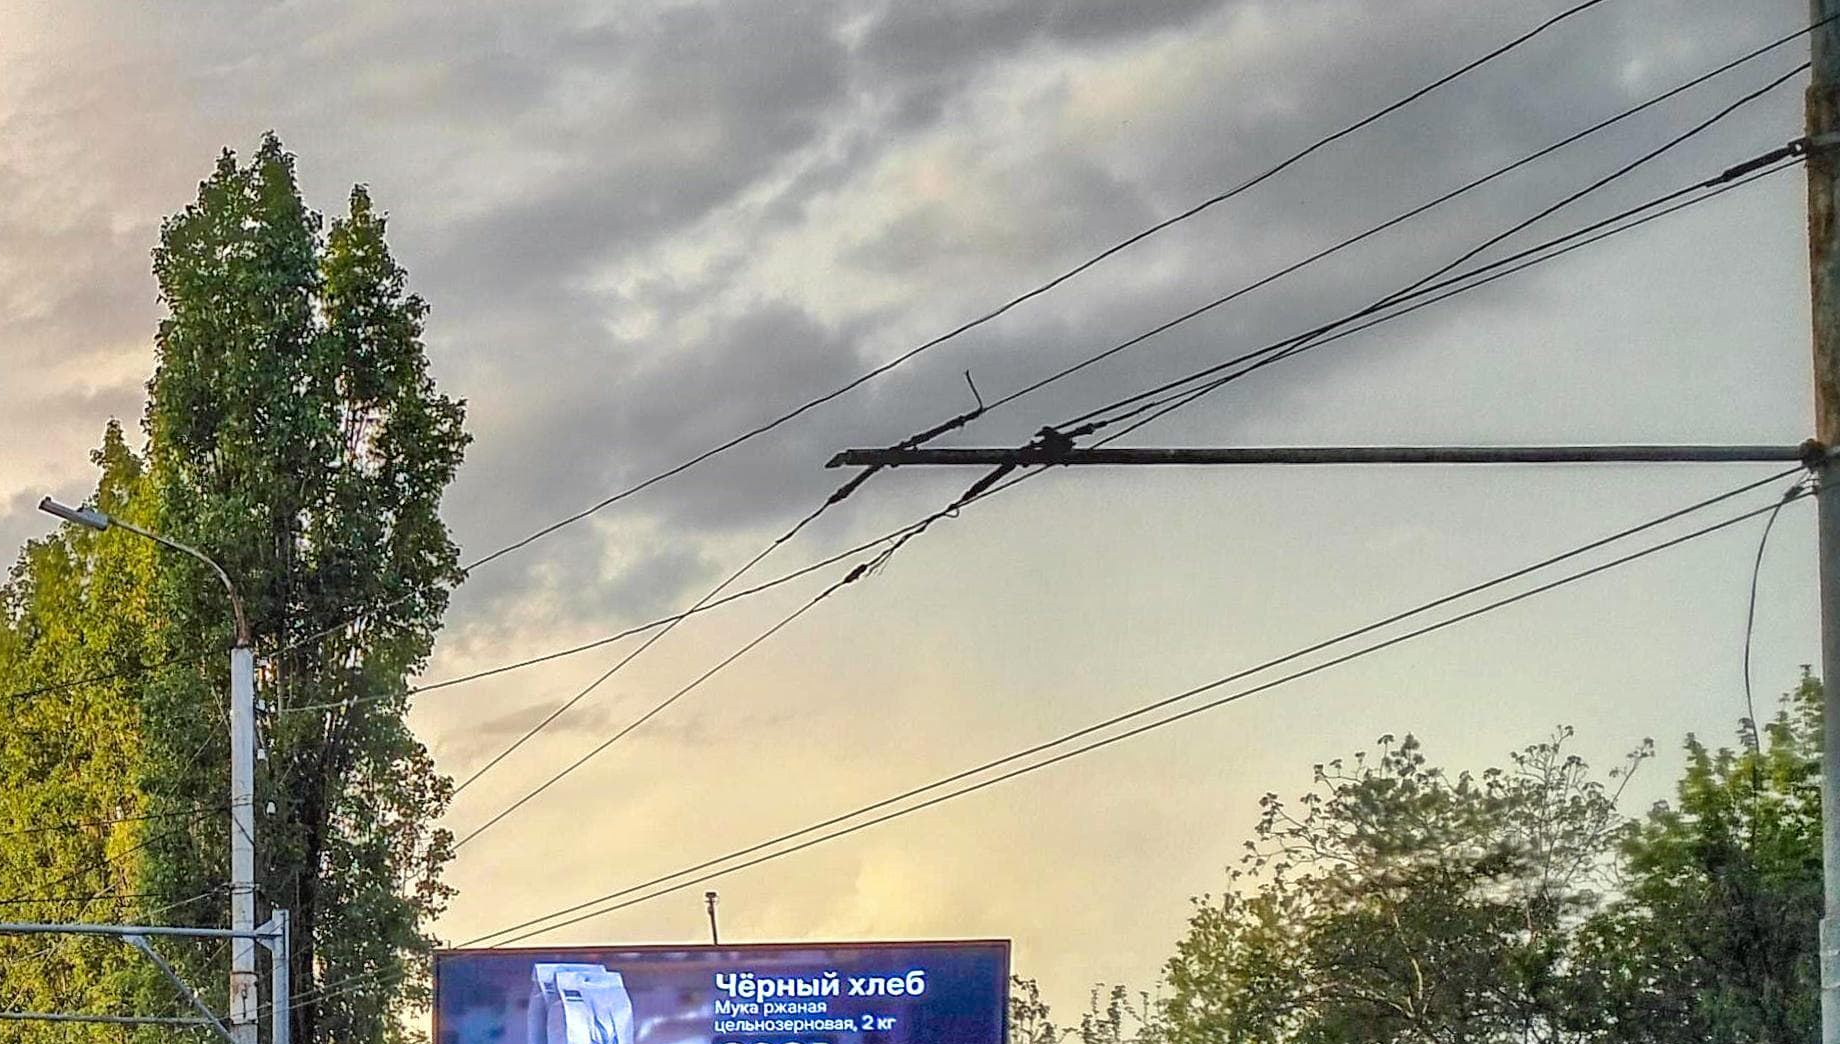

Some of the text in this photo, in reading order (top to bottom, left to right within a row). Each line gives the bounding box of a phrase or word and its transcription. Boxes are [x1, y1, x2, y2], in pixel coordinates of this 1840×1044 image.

[715, 970, 926, 1001] Чёрный хлеб
[714, 1001, 828, 1017] Мука ржаная
[714, 1014, 897, 1034] цельнозерновая, 2 кг
